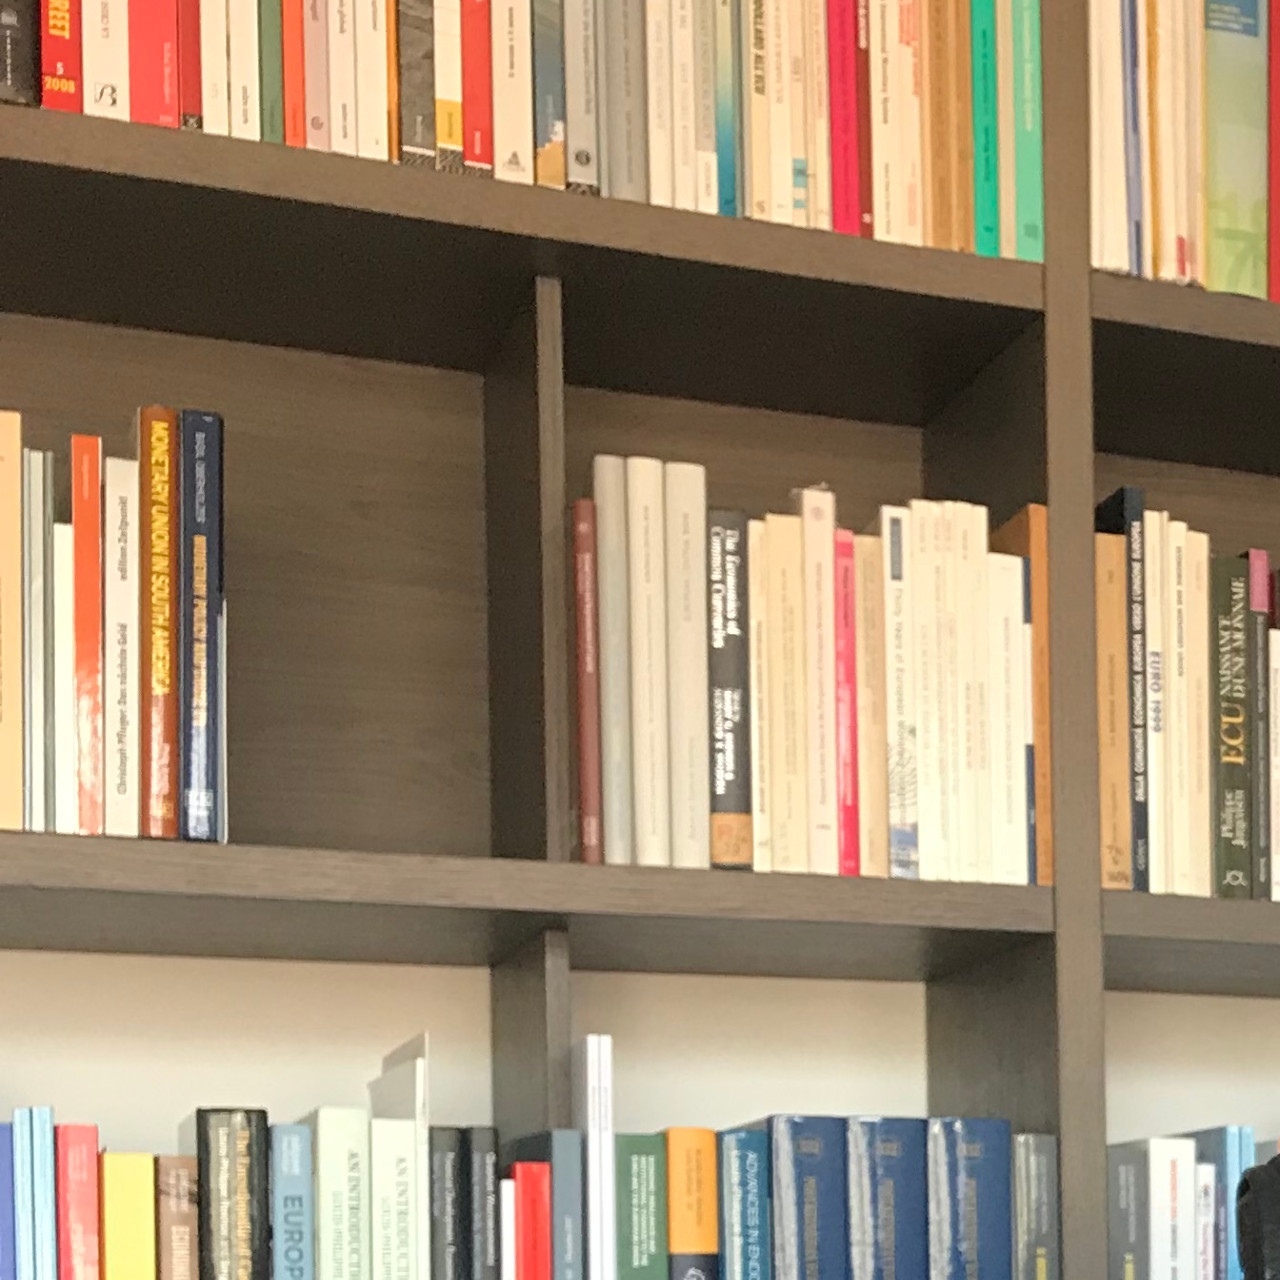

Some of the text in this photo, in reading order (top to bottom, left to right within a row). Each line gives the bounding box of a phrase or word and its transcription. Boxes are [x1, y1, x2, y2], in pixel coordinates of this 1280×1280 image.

[44, 75, 76, 94] 2008
[56, 61, 64, 76] 5
[151, 420, 170, 697] MONETARY UNION IN SOUTH AMERICA
[724, 529, 743, 635] The Economics of
[1218, 614, 1232, 698] NAISSANCE
[1230, 576, 1246, 699] D'UNE MONNAIE
[1148, 650, 1162, 694] EURO
[1219, 700, 1246, 766] ECU
[347, 1150, 361, 1175] AN
[395, 1156, 408, 1178] AN
[745, 1151, 760, 1228] ADVANCES
[747, 1228, 760, 1243] IN
